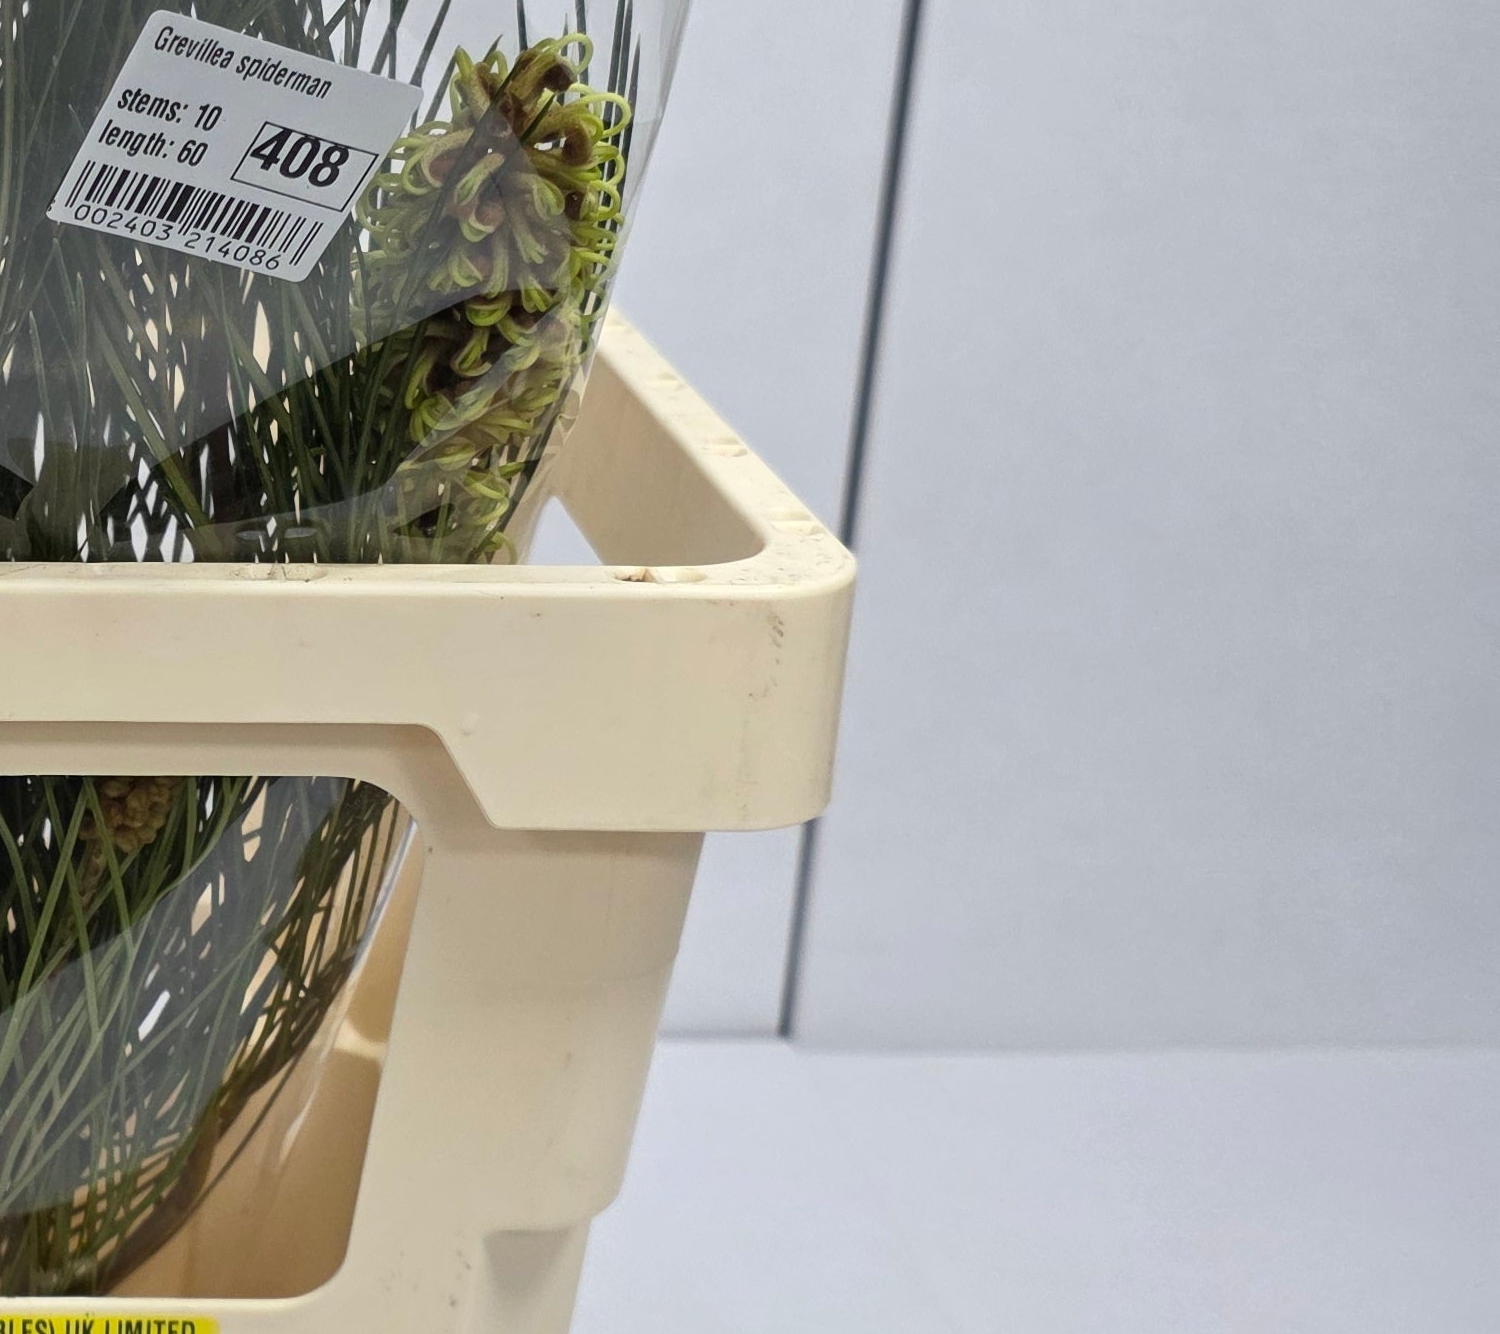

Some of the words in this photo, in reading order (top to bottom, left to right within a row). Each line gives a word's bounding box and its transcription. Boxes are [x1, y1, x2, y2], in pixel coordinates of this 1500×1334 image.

[155, 26, 234, 68] Grevillea
[236, 56, 332, 99] spiderman
[118, 88, 188, 123] stems:
[195, 104, 222, 131] 10
[99, 119, 174, 158] length:
[177, 140, 208, 166] 60
[250, 128, 349, 187] 408
[74, 204, 173, 241] 002403
[185, 232, 282, 270] 214086
